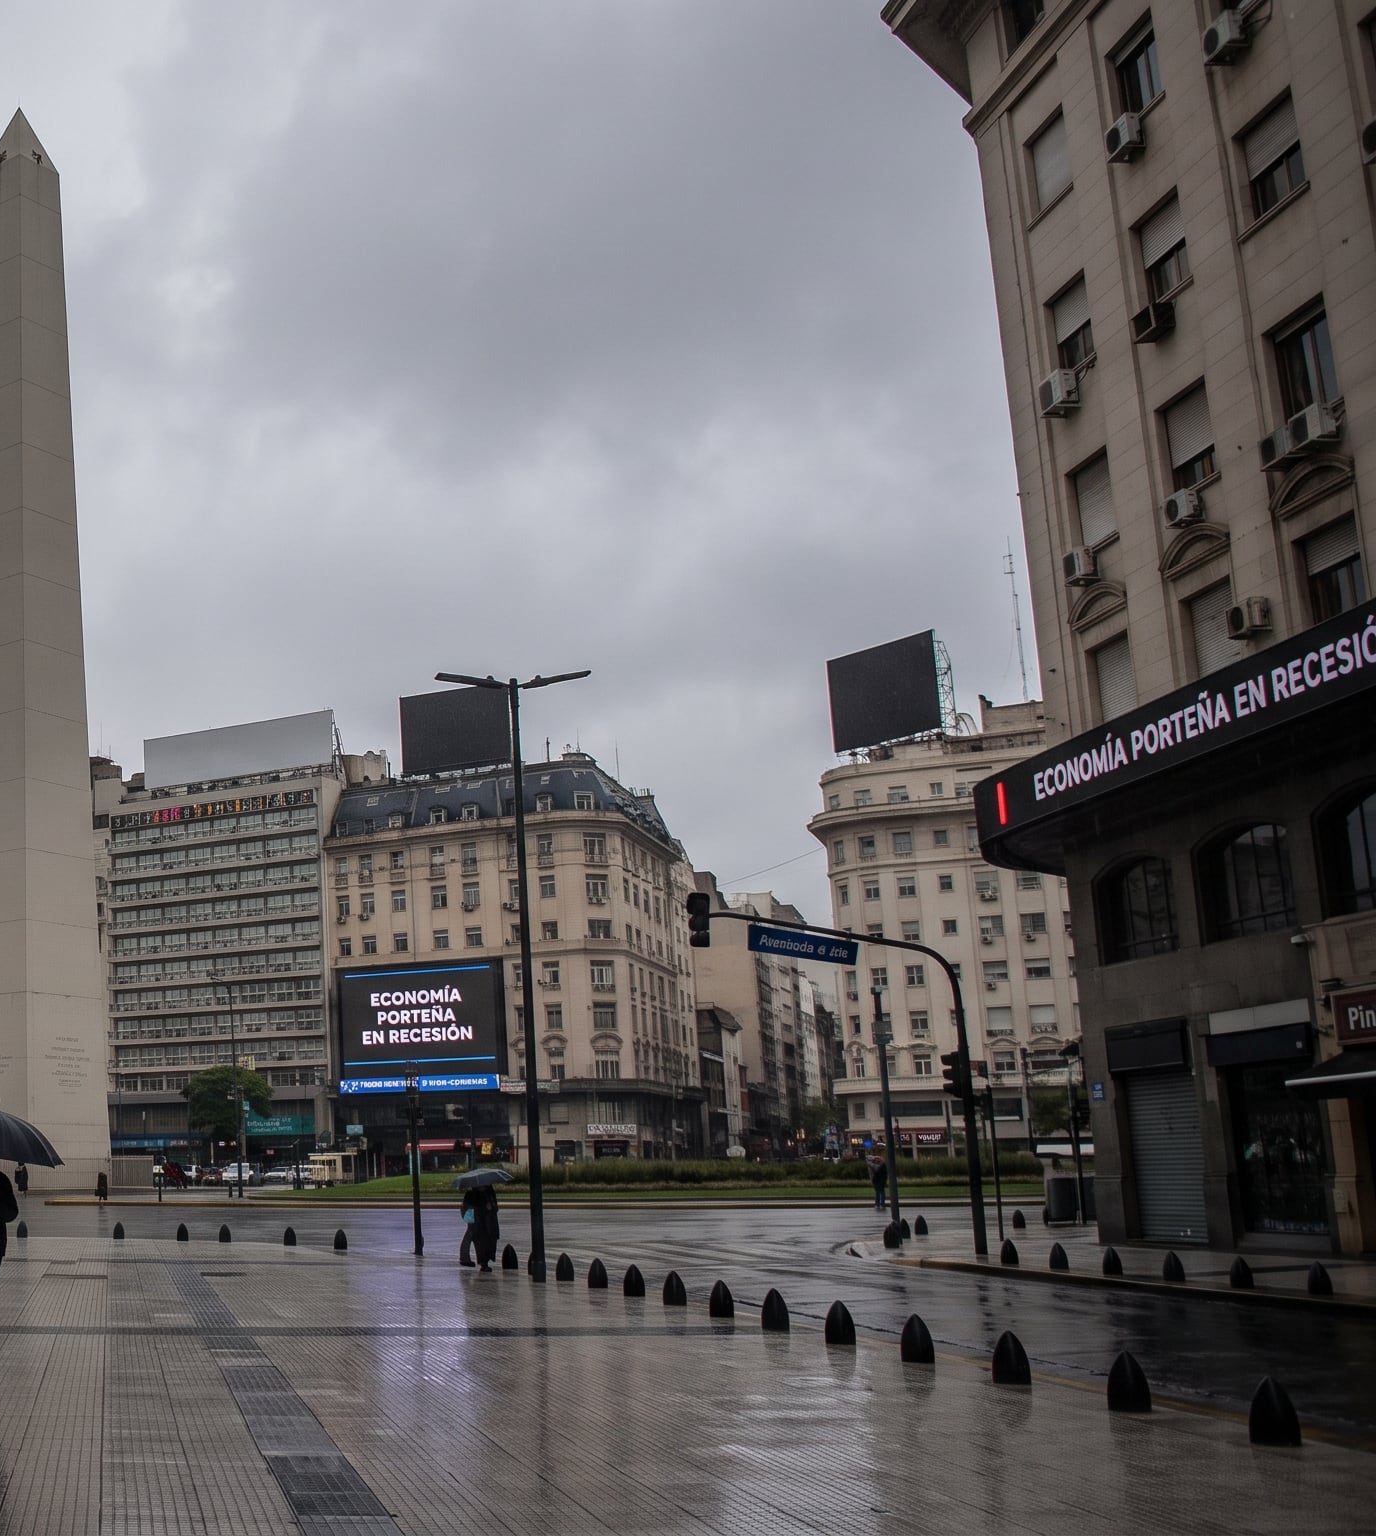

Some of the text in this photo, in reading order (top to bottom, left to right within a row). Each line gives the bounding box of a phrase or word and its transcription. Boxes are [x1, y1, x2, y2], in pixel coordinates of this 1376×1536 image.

[1033, 733, 1128, 801] ECONOMÍA
[1130, 691, 1232, 761] PORTEÑA
[1233, 675, 1267, 718] EN
[370, 985, 462, 1007] ECONOMÍA
[377, 1005, 456, 1025] PORTEÑA
[362, 1023, 473, 1045] EN RECESIÓN
